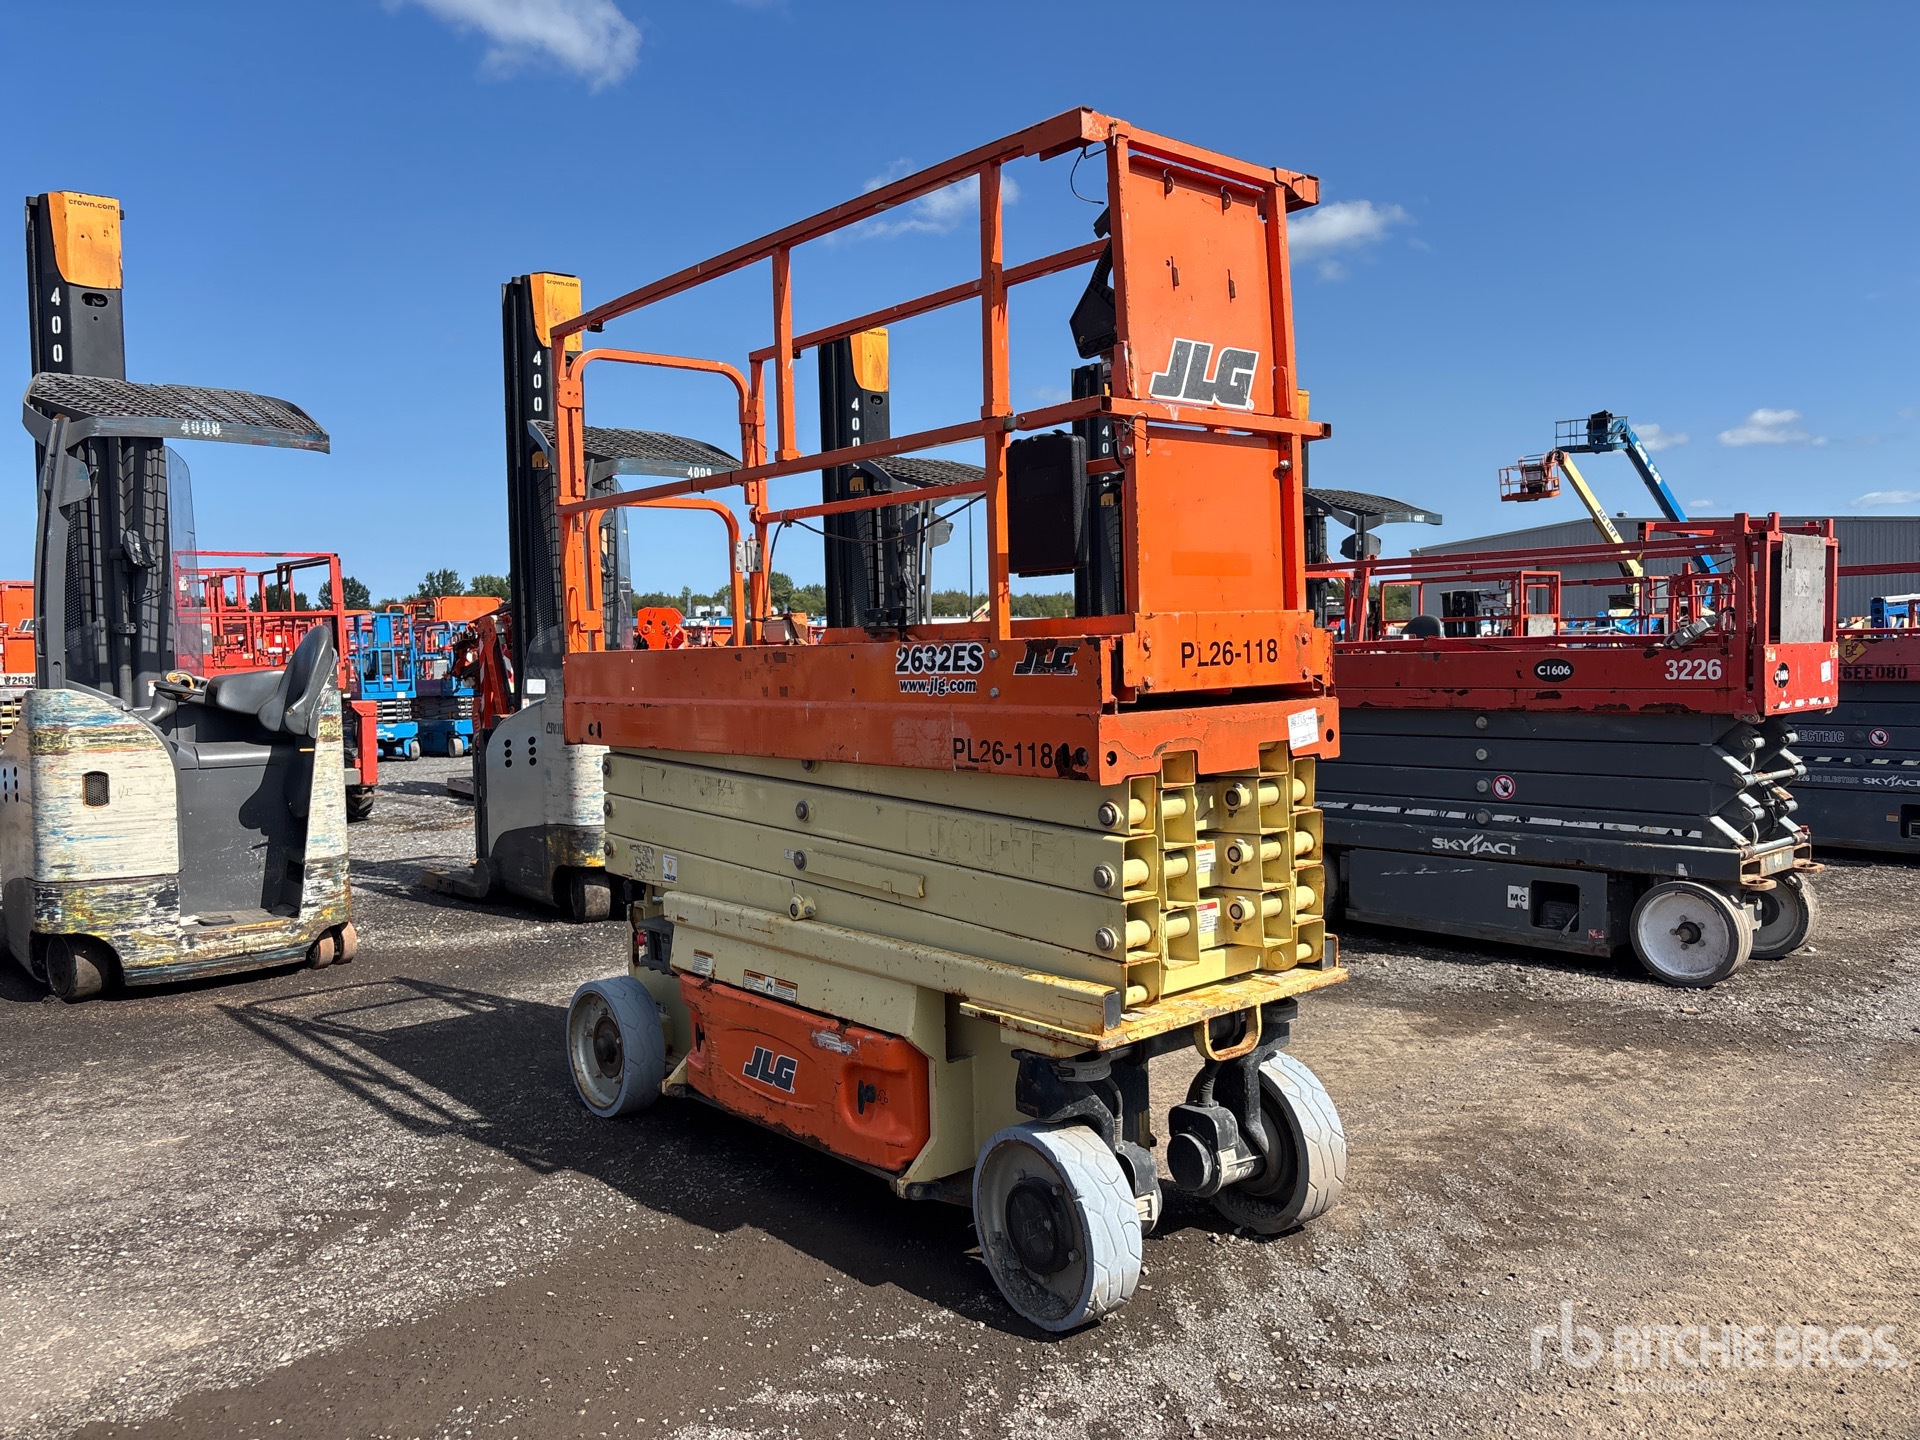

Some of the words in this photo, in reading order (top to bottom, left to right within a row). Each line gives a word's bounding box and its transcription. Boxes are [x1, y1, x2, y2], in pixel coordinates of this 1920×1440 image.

[68, 198, 116, 211] crown.com
[546, 279, 579, 288] crown.com
[1148, 337, 1260, 411] JLG
[180, 419, 222, 436] 4008
[687, 466, 712, 478] 4009
[895, 643, 985, 675] 2632ES
[1013, 646, 1081, 676] JLG
[1181, 638, 1278, 668] PL26-118
[1664, 658, 1722, 681] 3226
[899, 676, 977, 697] www.jlg.com
[1797, 730, 1845, 743] ECTRIC
[952, 737, 1054, 769] PL26-118
[1510, 893, 1527, 903] MC
[742, 1045, 799, 1094] JLG
